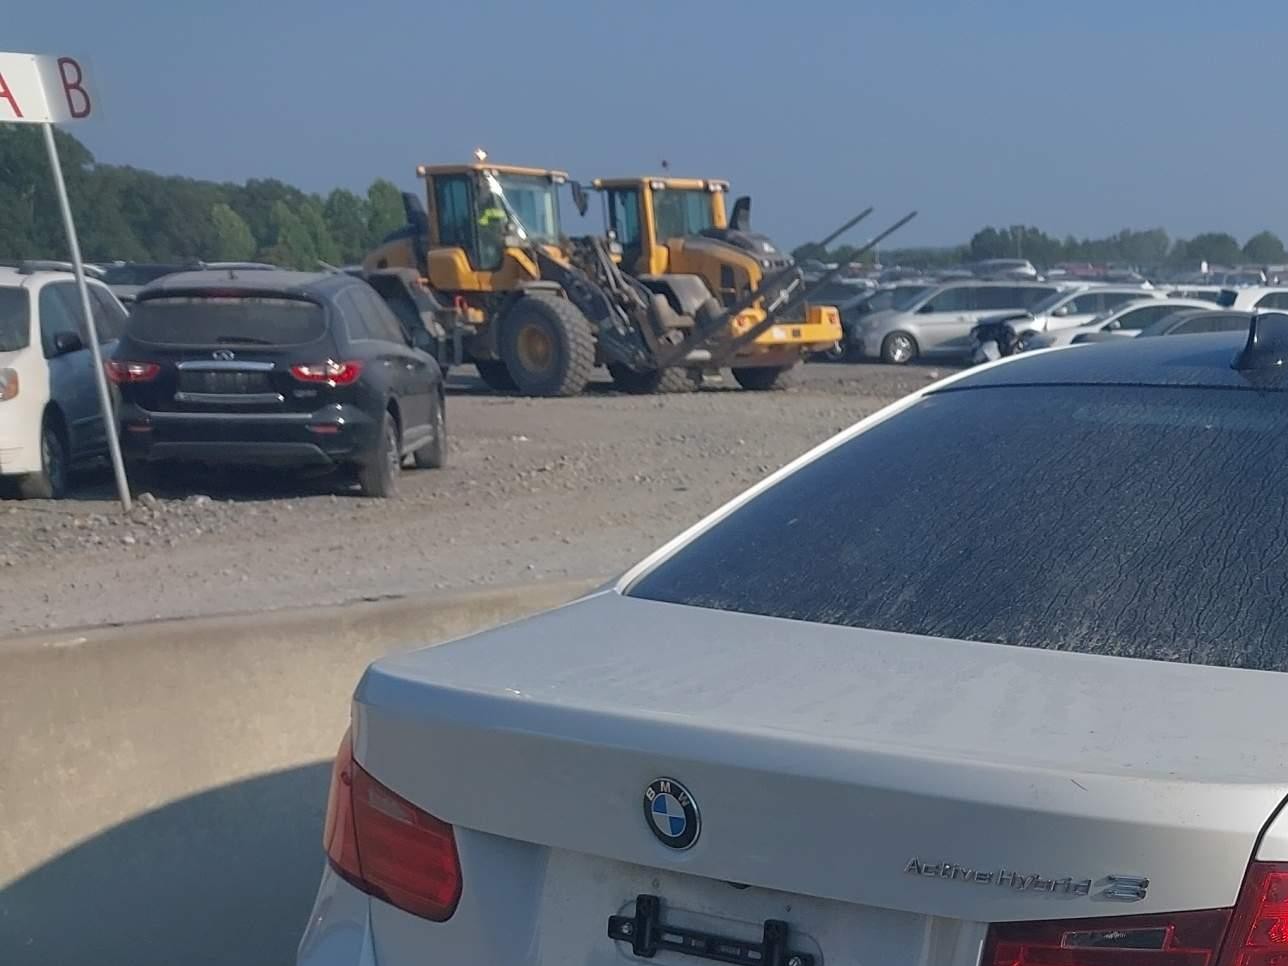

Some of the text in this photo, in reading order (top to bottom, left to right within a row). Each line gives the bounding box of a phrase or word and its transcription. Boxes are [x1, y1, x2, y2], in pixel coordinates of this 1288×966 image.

[57, 57, 91, 119] B
[646, 781, 690, 807] BMW
[1100, 873, 1150, 901] 3
